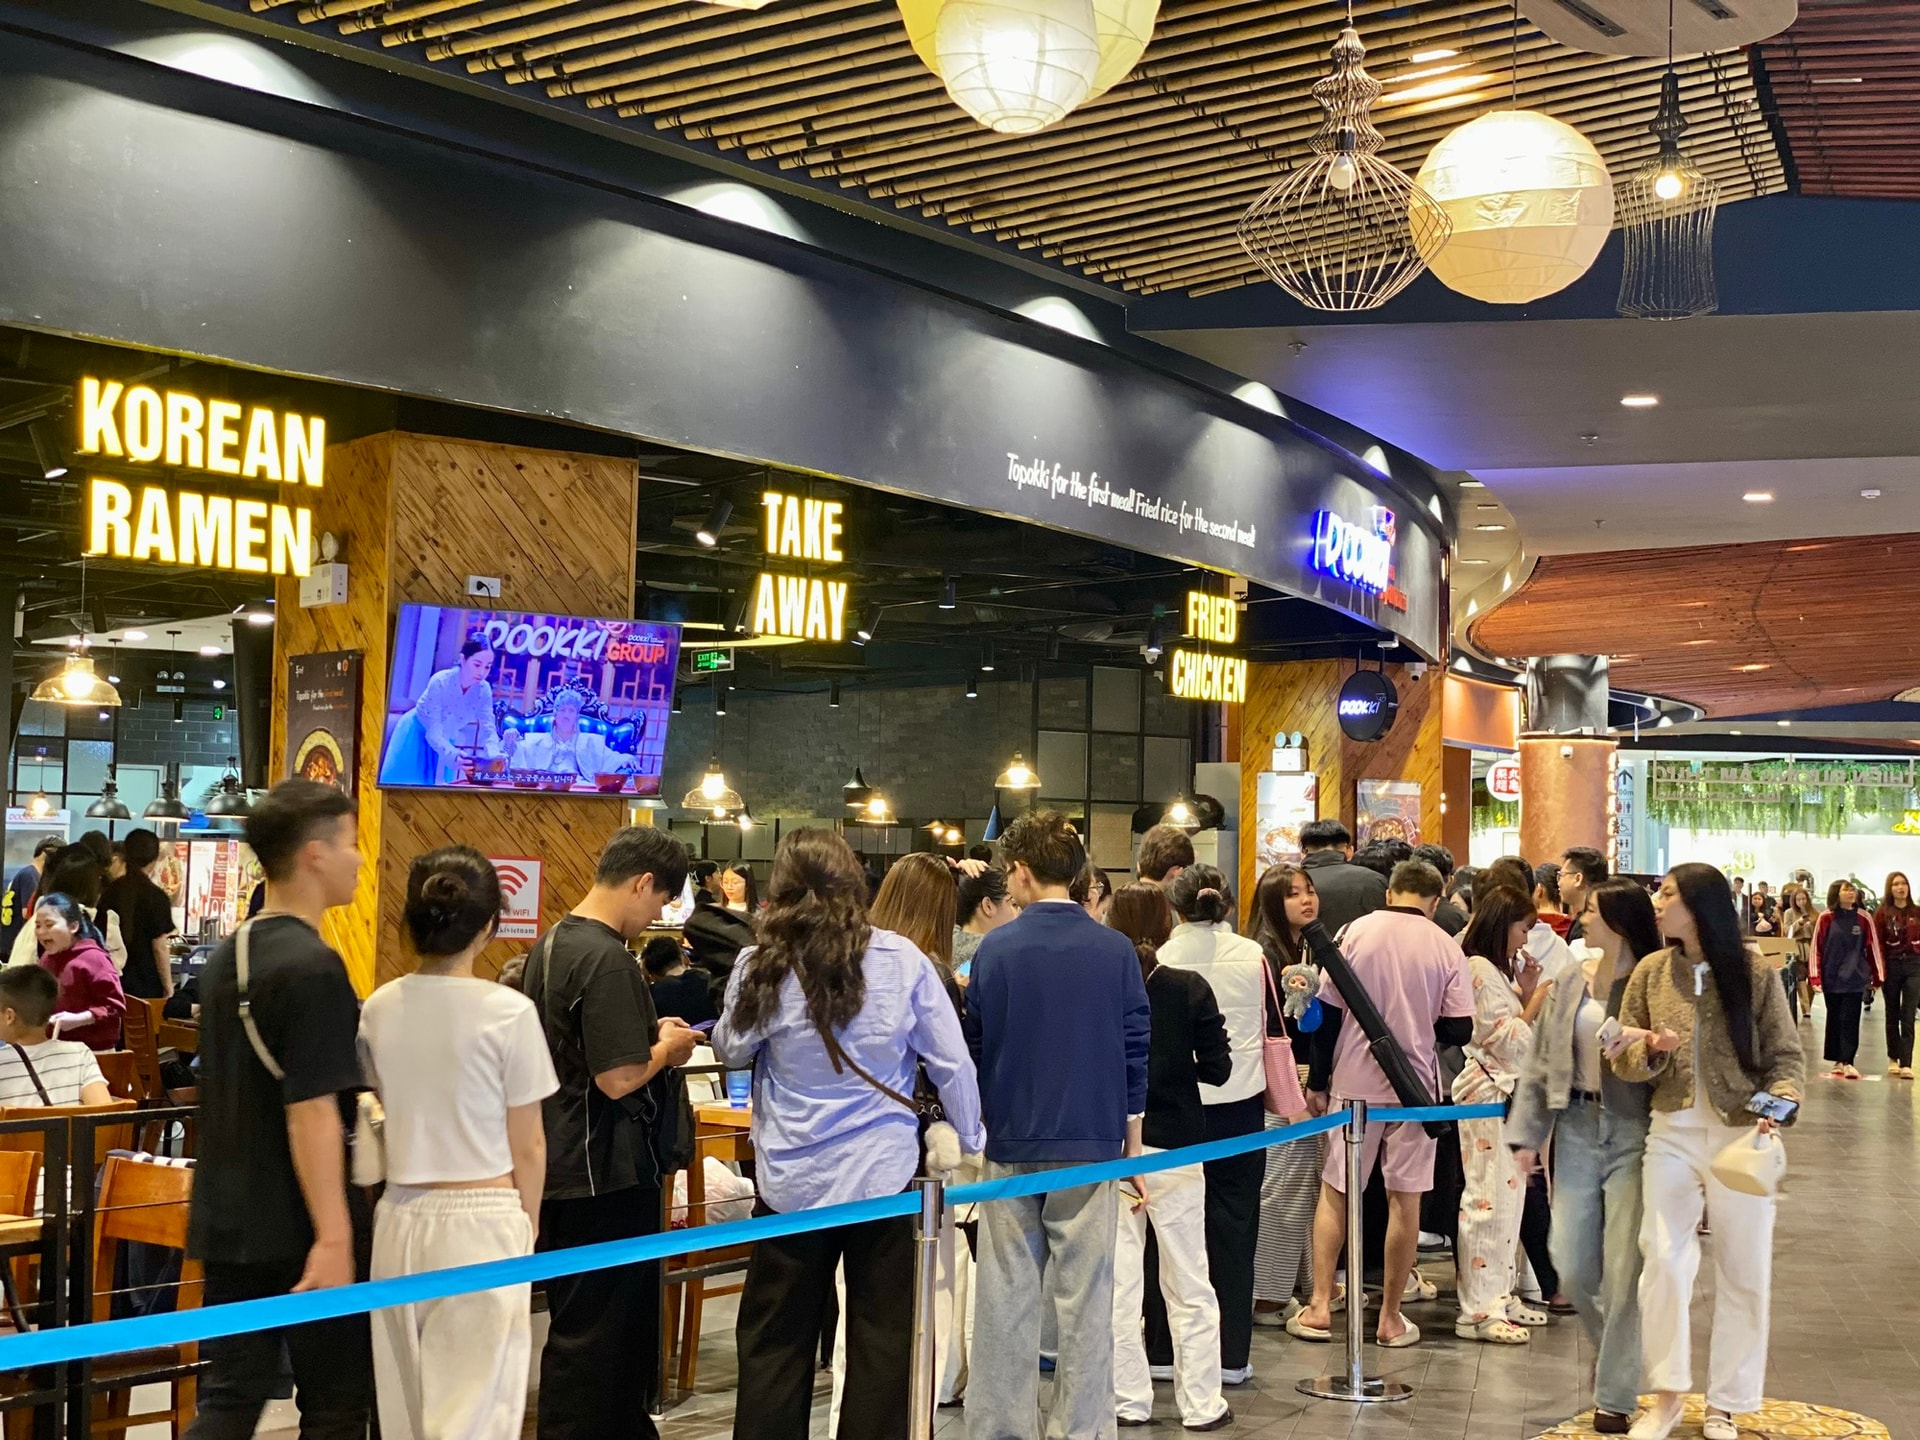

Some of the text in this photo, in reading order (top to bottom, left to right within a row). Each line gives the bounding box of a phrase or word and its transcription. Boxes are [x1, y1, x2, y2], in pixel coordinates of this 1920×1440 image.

[82, 376, 326, 487] KOREAN
[90, 478, 312, 578] RAMEN
[763, 491, 843, 562] TAKE
[1007, 452, 1050, 491] Topokki
[1051, 463, 1069, 500] for
[1070, 471, 1087, 500] the
[1088, 472, 1110, 508] first
[1136, 492, 1161, 520] Fried
[1161, 503, 1178, 525] rice
[1179, 500, 1193, 534] for
[1194, 507, 1208, 533] the
[1209, 519, 1238, 542] second
[754, 573, 847, 641] AWAY
[1188, 591, 1237, 643] FRIED
[484, 620, 610, 661] DOOKKI
[607, 642, 666, 664] GROUP
[1172, 648, 1247, 704] CHICKEN
[1339, 699, 1380, 715] DOOKKI
